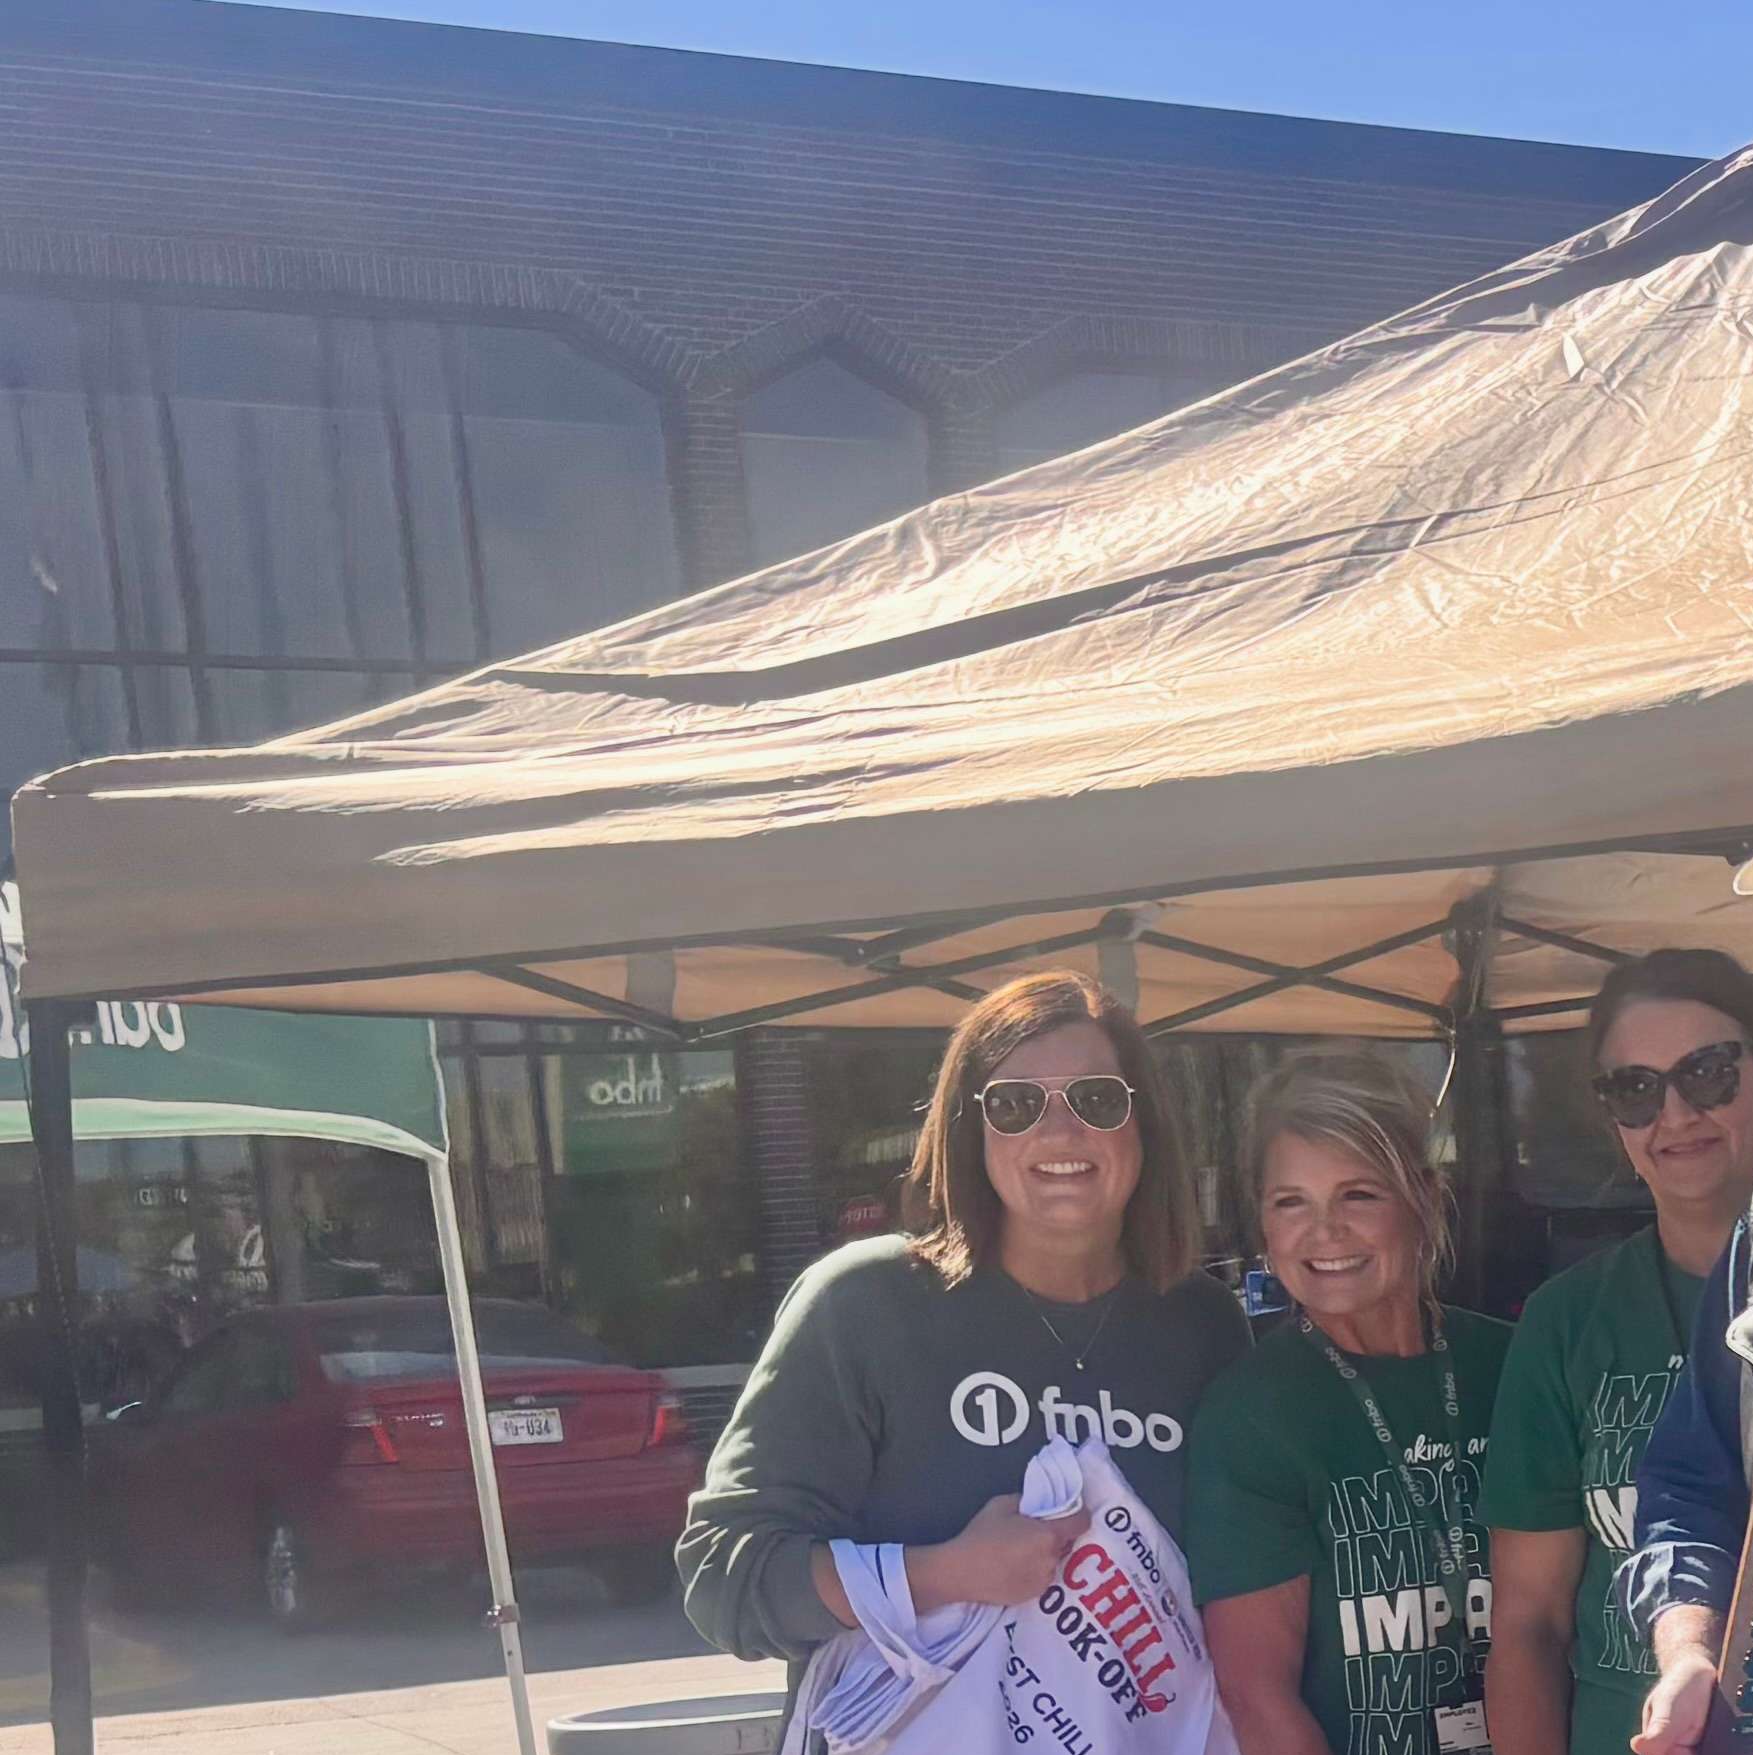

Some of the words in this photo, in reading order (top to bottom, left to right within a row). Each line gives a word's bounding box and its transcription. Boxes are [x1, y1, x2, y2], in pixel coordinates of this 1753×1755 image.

[1038, 1385, 1184, 1453] fnbo
[1126, 1531, 1161, 1584] fnbo
[1339, 1578, 1493, 1656] IMPA
[1038, 1585, 1149, 1724] OOK-OFF
